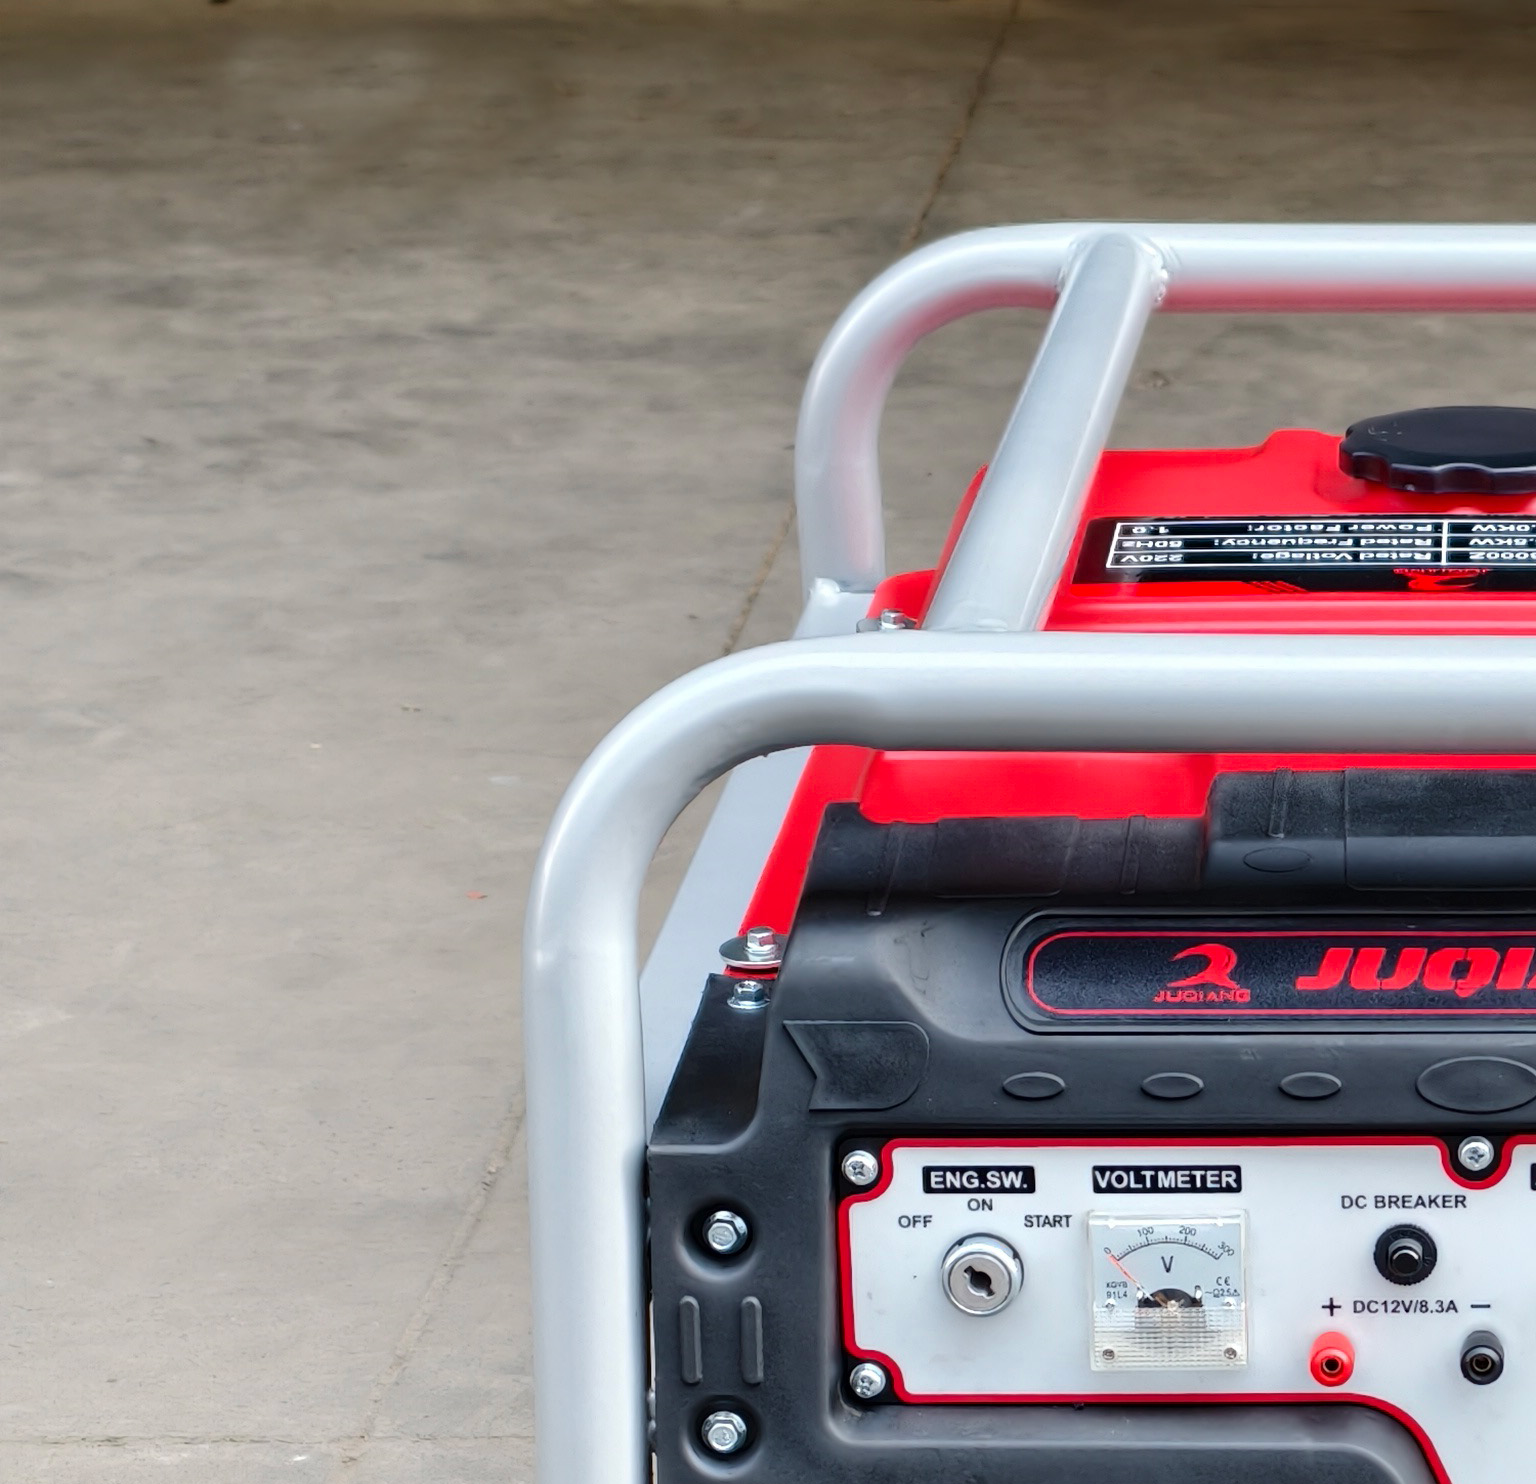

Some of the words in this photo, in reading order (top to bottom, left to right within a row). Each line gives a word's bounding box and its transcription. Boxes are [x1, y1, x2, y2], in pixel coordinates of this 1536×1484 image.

[1360, 538, 1432, 546] Rated
[1120, 554, 1184, 563] 220V
[1360, 552, 1432, 560] Rated
[930, 1170, 1028, 1189] ENG.SW.
[967, 1198, 993, 1212] ON
[1340, 1194, 1367, 1209] DC
[1374, 1194, 1467, 1209] BREAKER
[898, 1215, 933, 1229] OFF
[1024, 1214, 1073, 1228] START
[1137, 1226, 1155, 1237] 100
[1179, 1225, 1197, 1237] 200
[1217, 1241, 1235, 1257] 300
[1161, 1255, 1174, 1273] V
[1353, 1299, 1459, 1314] DC12V/8.3A
